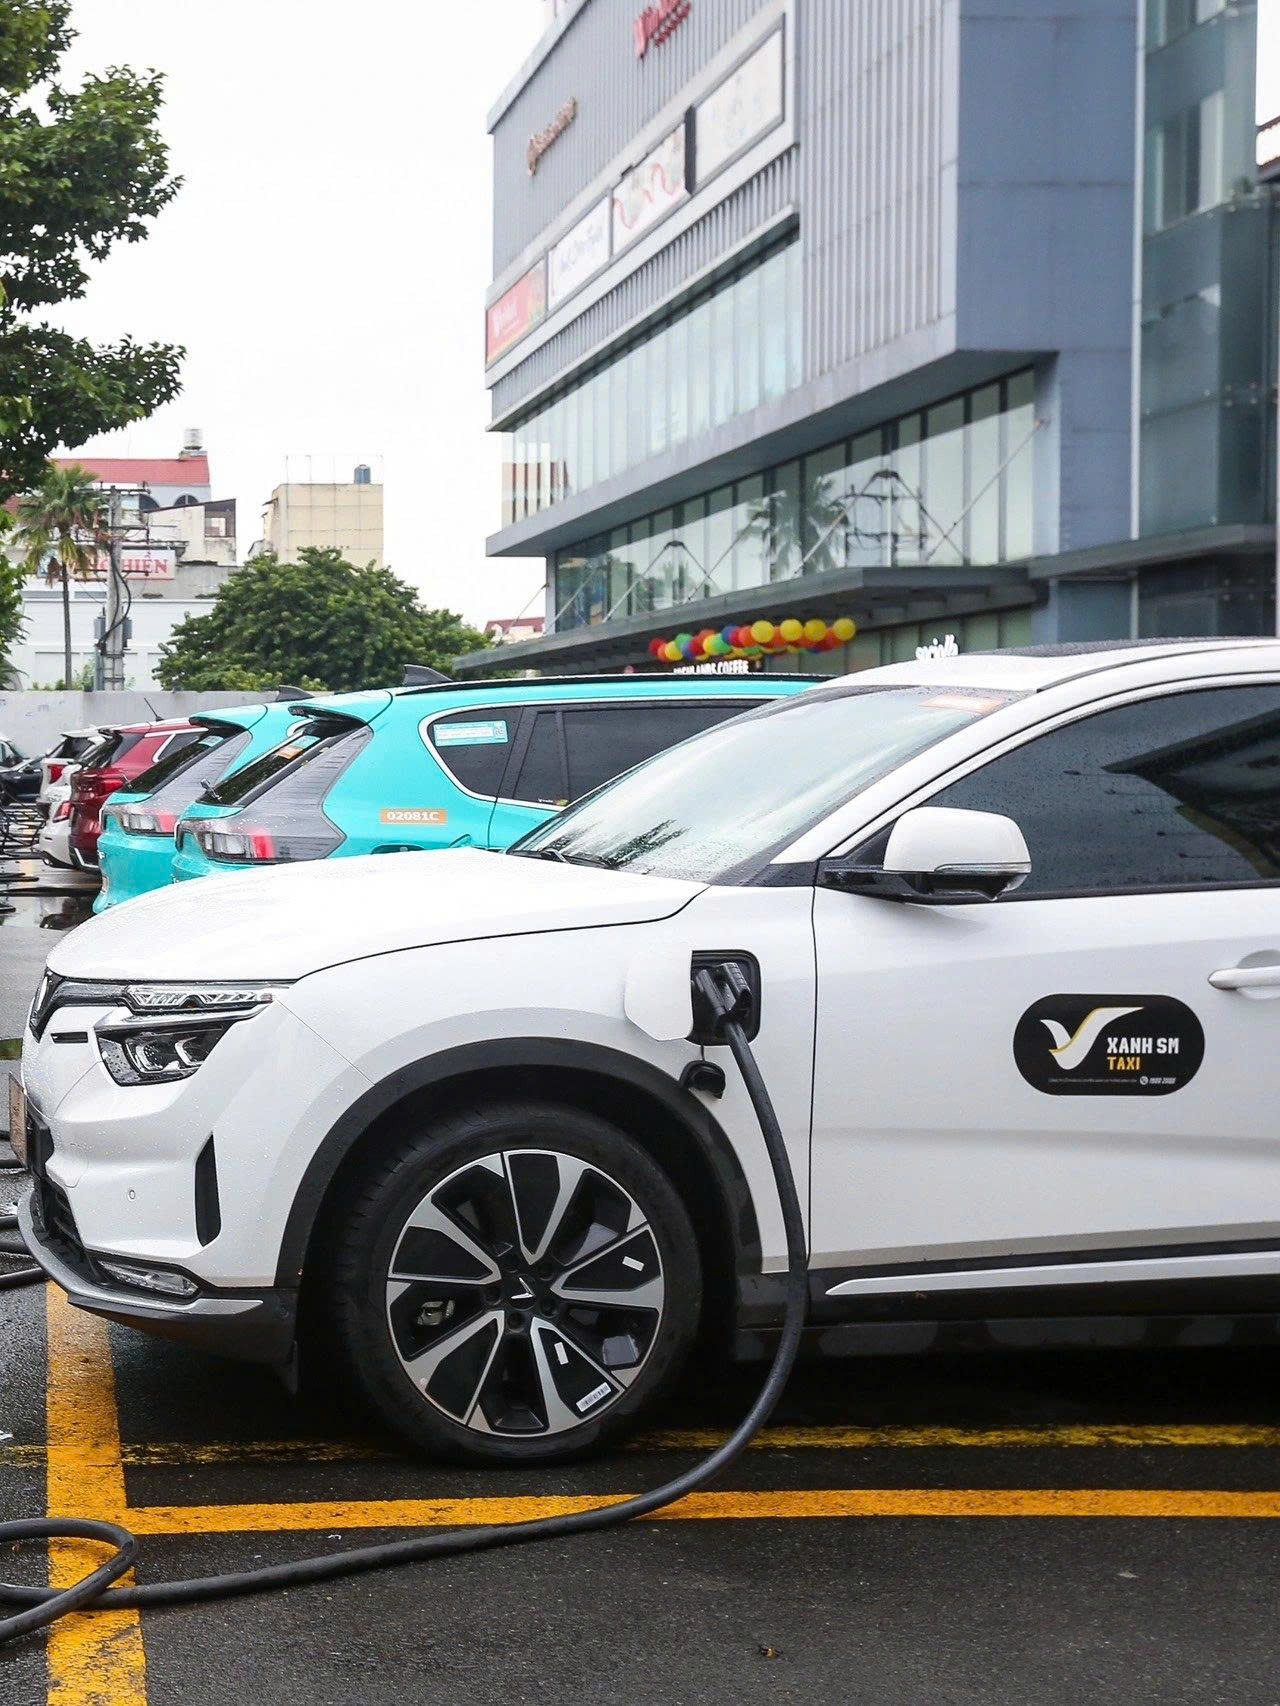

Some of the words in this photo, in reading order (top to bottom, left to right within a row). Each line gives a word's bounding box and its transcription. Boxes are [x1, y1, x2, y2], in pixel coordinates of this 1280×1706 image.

[386, 811, 440, 821] 02081C
[1106, 1037, 1153, 1054] XANH
[1156, 1037, 1180, 1055] SM
[1106, 1056, 1141, 1071] TAXI
